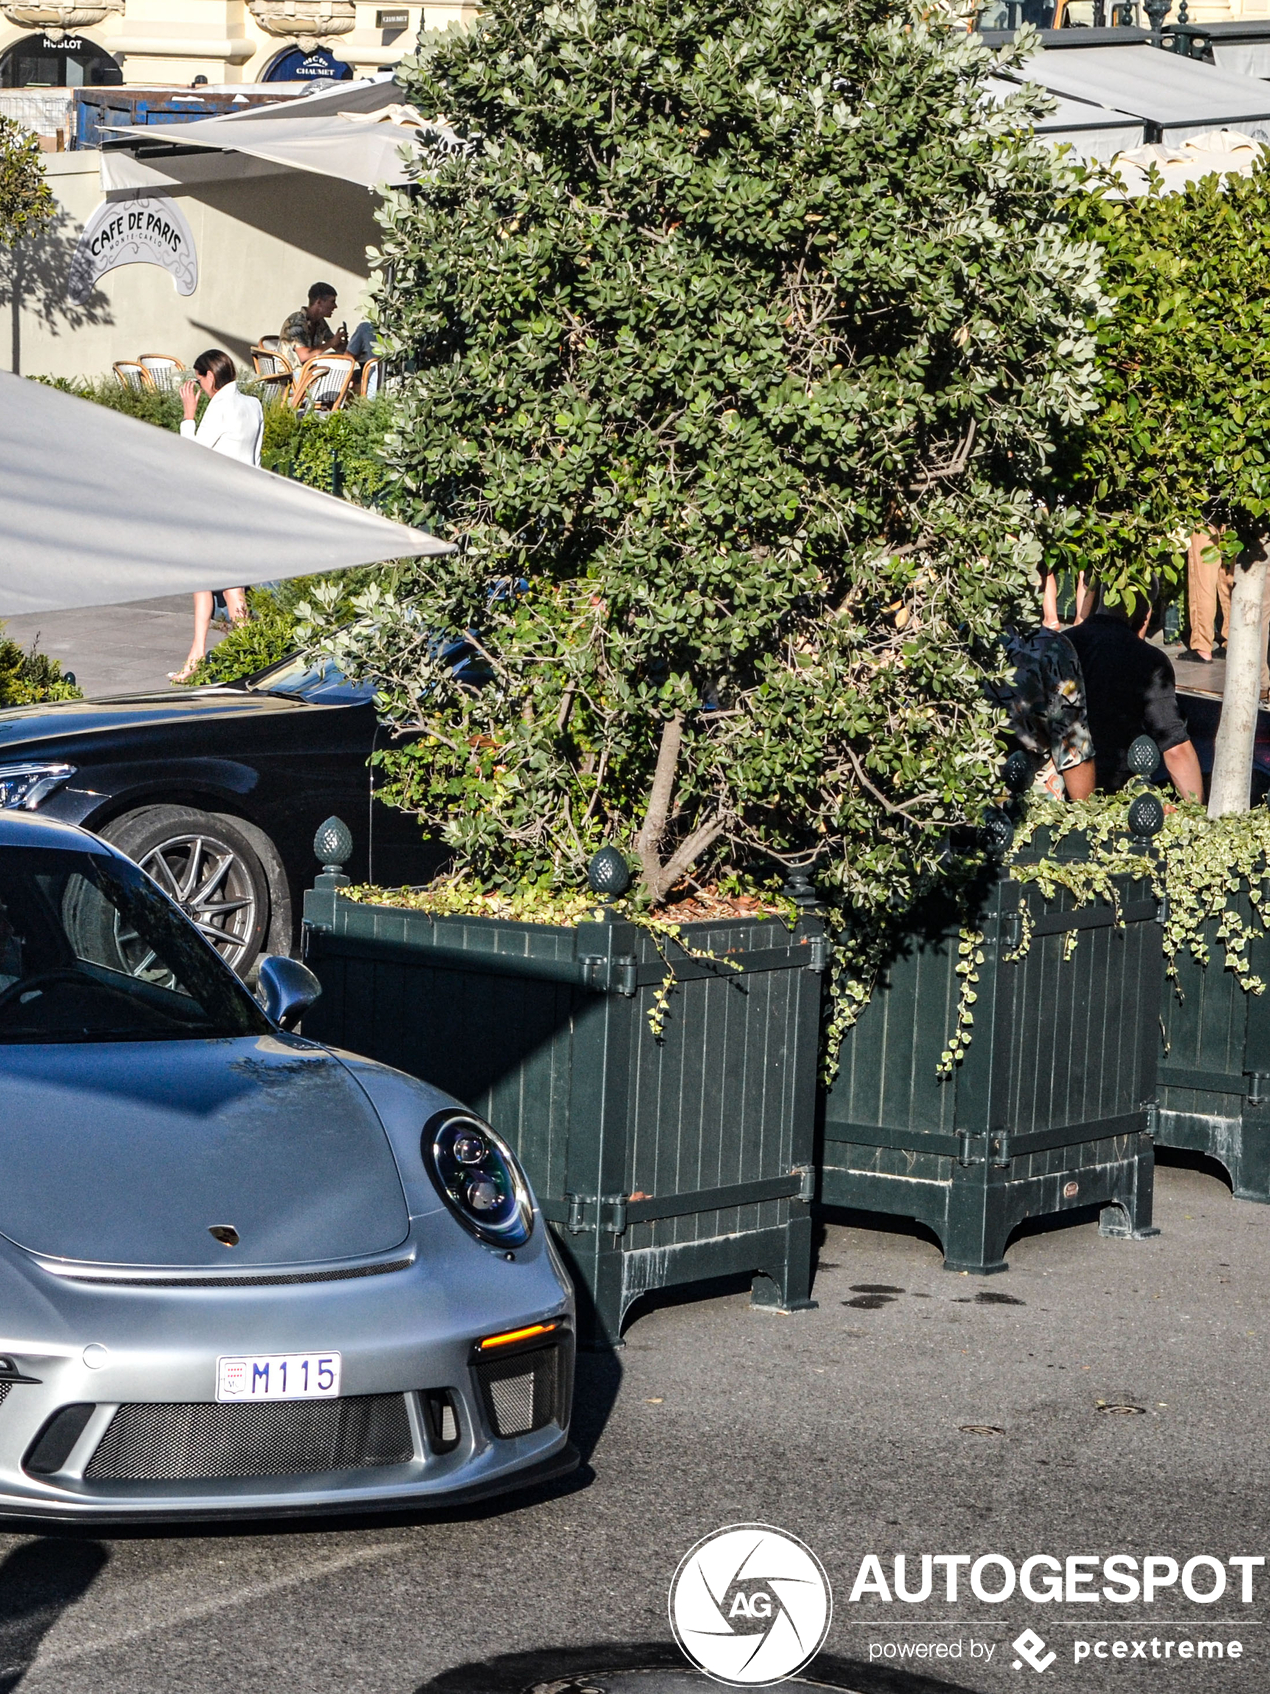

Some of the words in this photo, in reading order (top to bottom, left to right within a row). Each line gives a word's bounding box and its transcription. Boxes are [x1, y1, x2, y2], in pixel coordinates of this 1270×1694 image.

[295, 67, 335, 76] CHAUMET
[91, 216, 124, 256] CAFE
[128, 212, 144, 231] DE
[146, 213, 182, 252] PARIS
[252, 1359, 334, 1394] M115
